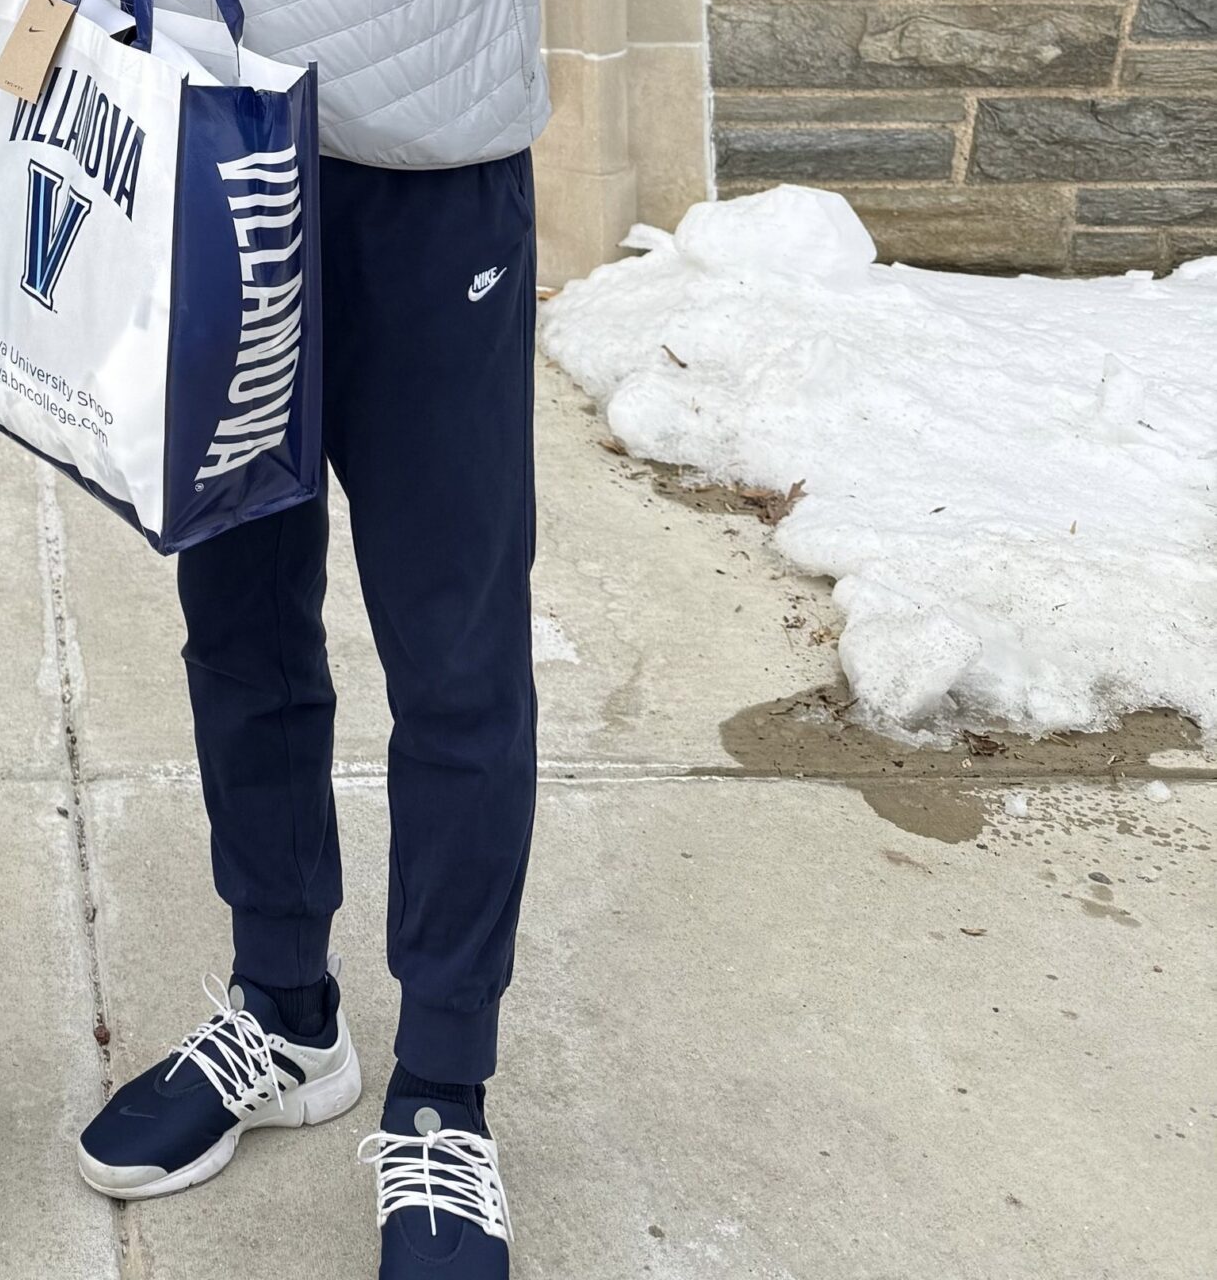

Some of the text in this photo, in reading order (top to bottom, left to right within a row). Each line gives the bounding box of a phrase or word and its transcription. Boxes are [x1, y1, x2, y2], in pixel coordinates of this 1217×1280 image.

[20, 158, 93, 312] V
[194, 142, 303, 481] VILLANOVA
[10, 345, 74, 402] University
[77, 390, 114, 426] Shop
